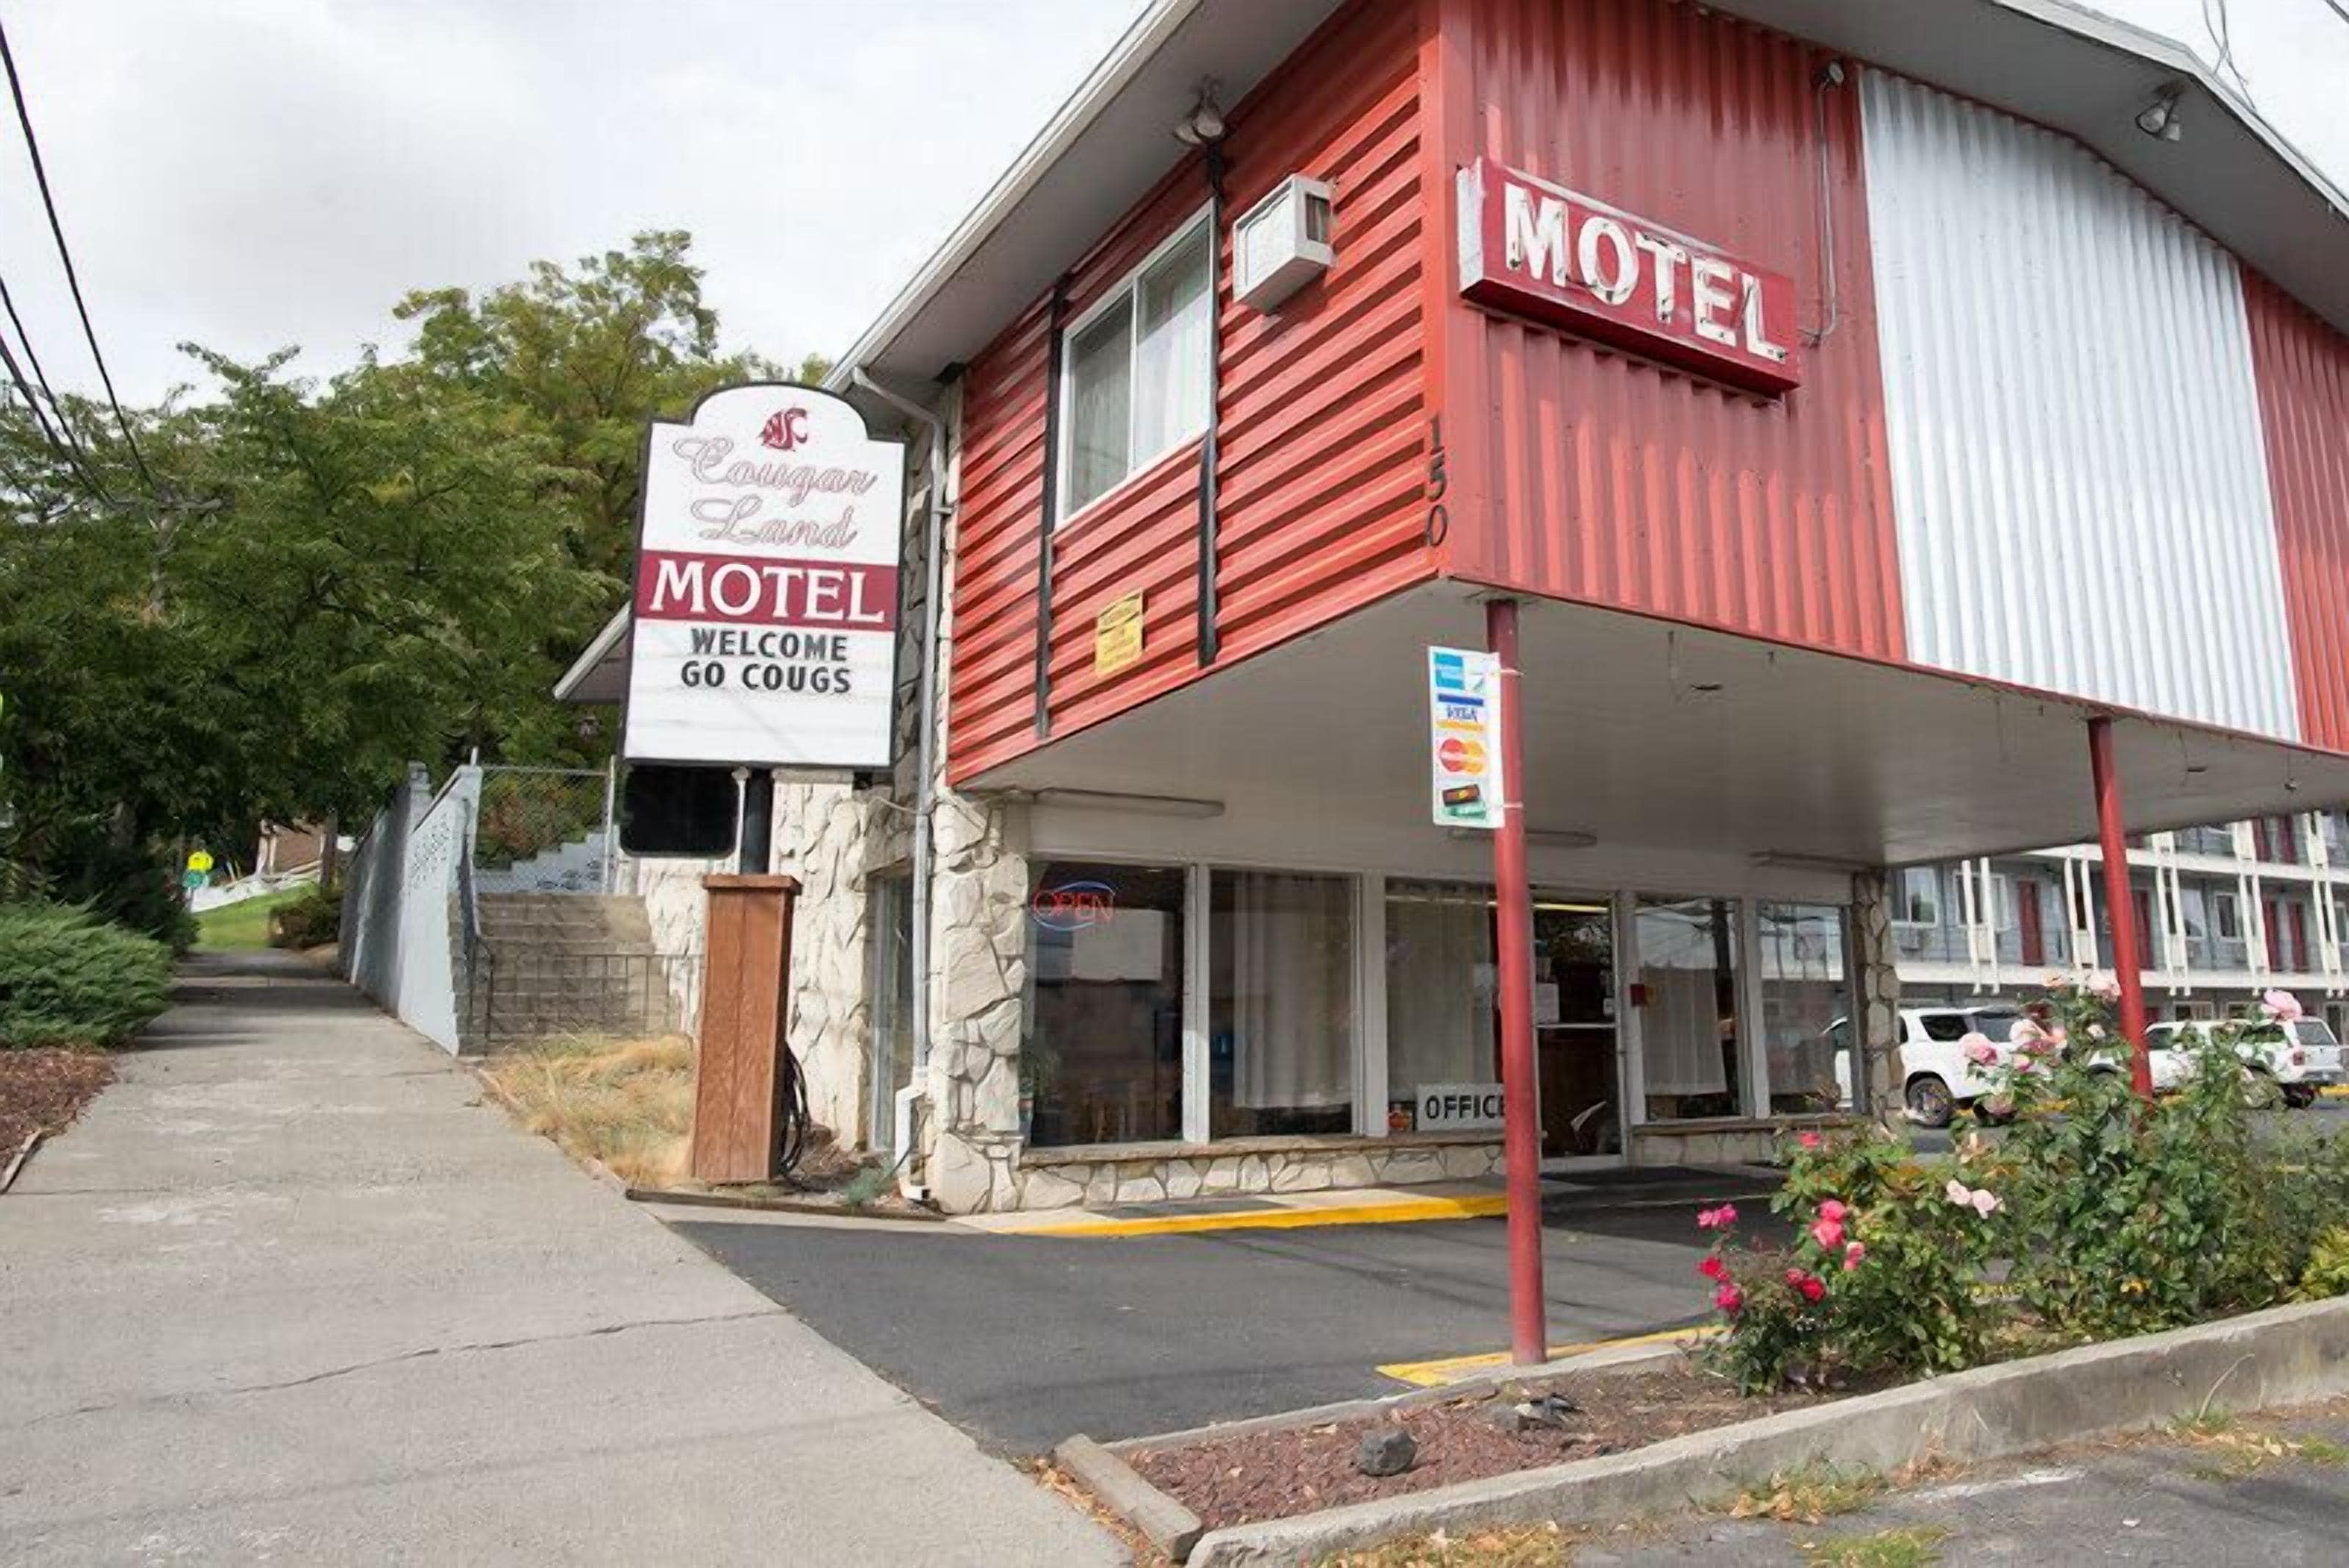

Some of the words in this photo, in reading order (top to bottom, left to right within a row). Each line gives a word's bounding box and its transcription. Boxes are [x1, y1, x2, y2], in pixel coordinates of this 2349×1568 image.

[1504, 181, 1789, 363] MOTEL
[672, 437, 878, 507] Cougar
[1427, 413, 1448, 547] 150
[690, 493, 858, 549] Land
[649, 559, 885, 624] MOTEL
[690, 628, 849, 661] WELCOME
[680, 661, 725, 689] GO
[741, 663, 852, 694] COUGS
[1034, 890, 1114, 921] OPEN
